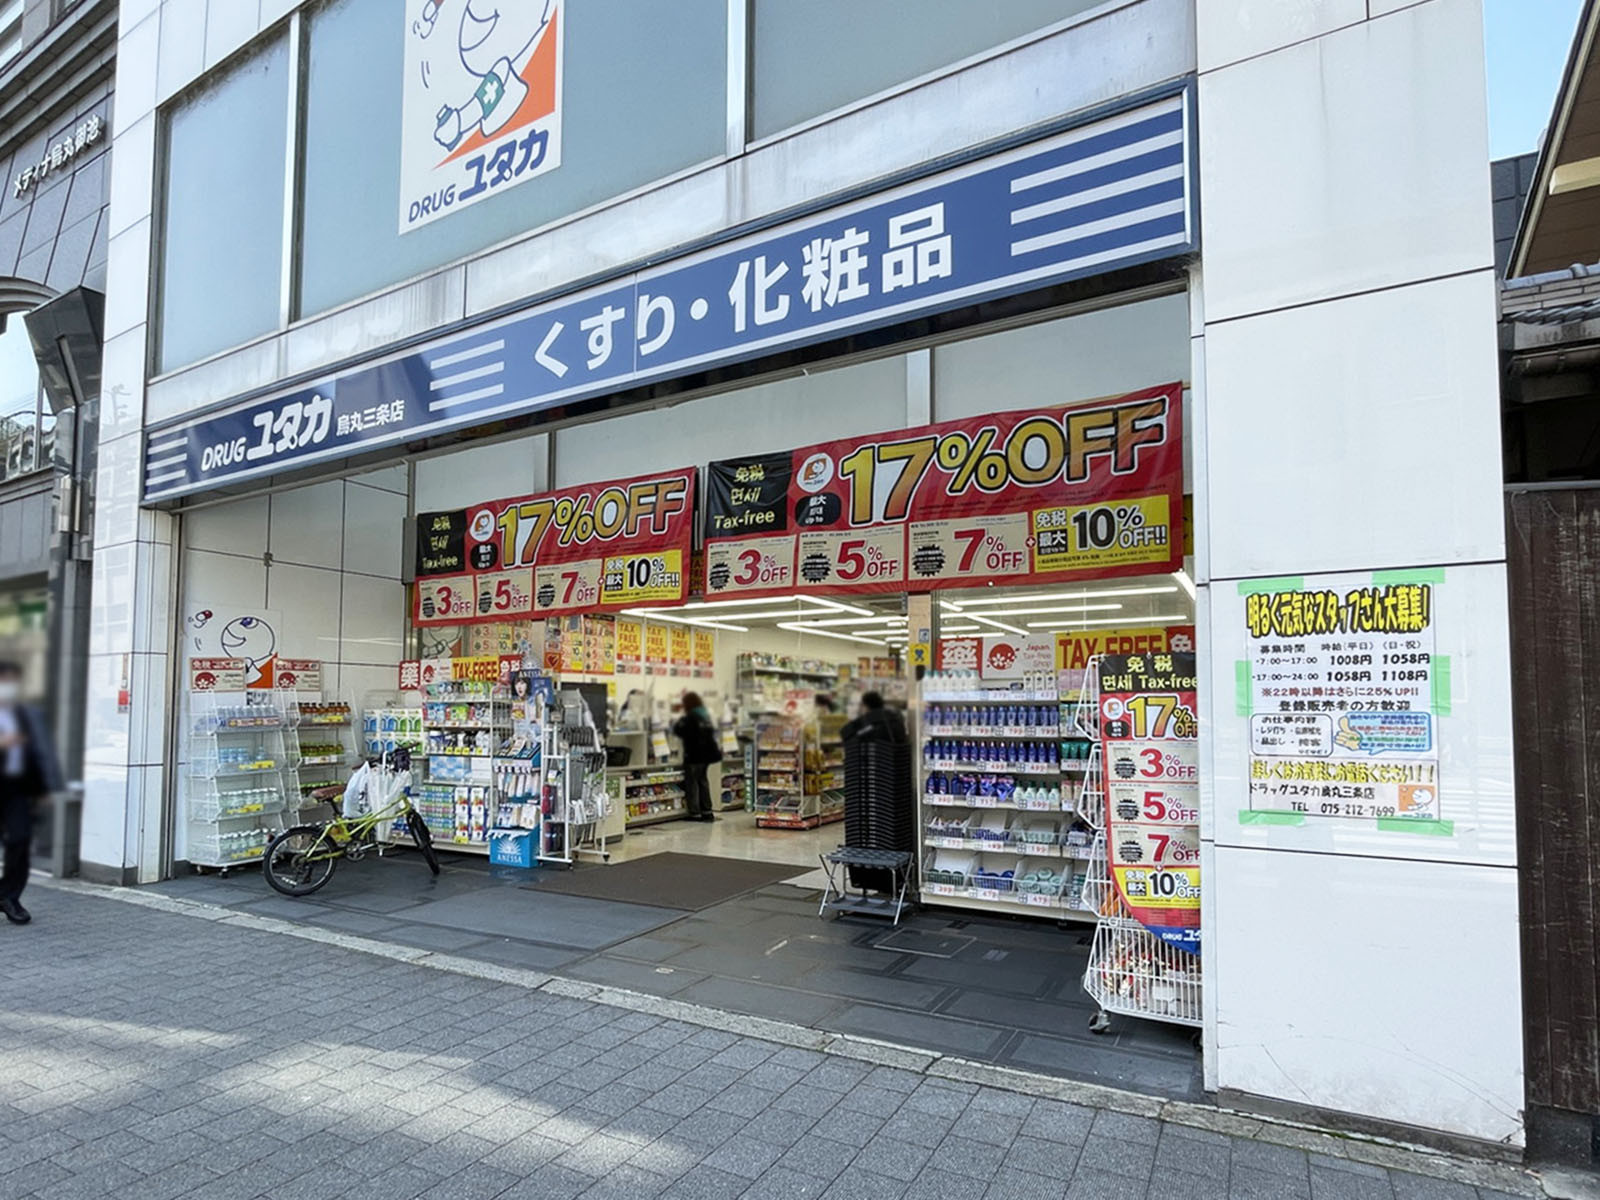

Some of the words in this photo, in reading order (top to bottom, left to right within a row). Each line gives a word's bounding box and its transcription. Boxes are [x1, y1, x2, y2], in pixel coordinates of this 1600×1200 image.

[408, 184, 456, 223] DRUG
[458, 128, 549, 202] ユタカ
[533, 201, 953, 379] くすり・化粧品
[201, 436, 247, 472] DRUG
[246, 394, 333, 461] ユタカ
[714, 509, 775, 529] Tax-free
[866, 559, 899, 577] OFF
[986, 552, 1023, 569] OFF
[760, 566, 788, 582] OFF
[512, 595, 528, 608] OFF
[577, 587, 595, 601] OFF
[452, 602, 471, 613] OFF
[1330, 654, 1372, 666] 1008円
[1382, 653, 1431, 665] 1058円
[1102, 674, 1133, 691] 면세
[1138, 673, 1198, 689] Tax-free
[1326, 671, 1372, 682] 1058円
[1382, 670, 1428, 681] 1108円
[1166, 766, 1197, 777] OFF
[1291, 801, 1309, 812] TEL
[1168, 809, 1198, 821] OFF
